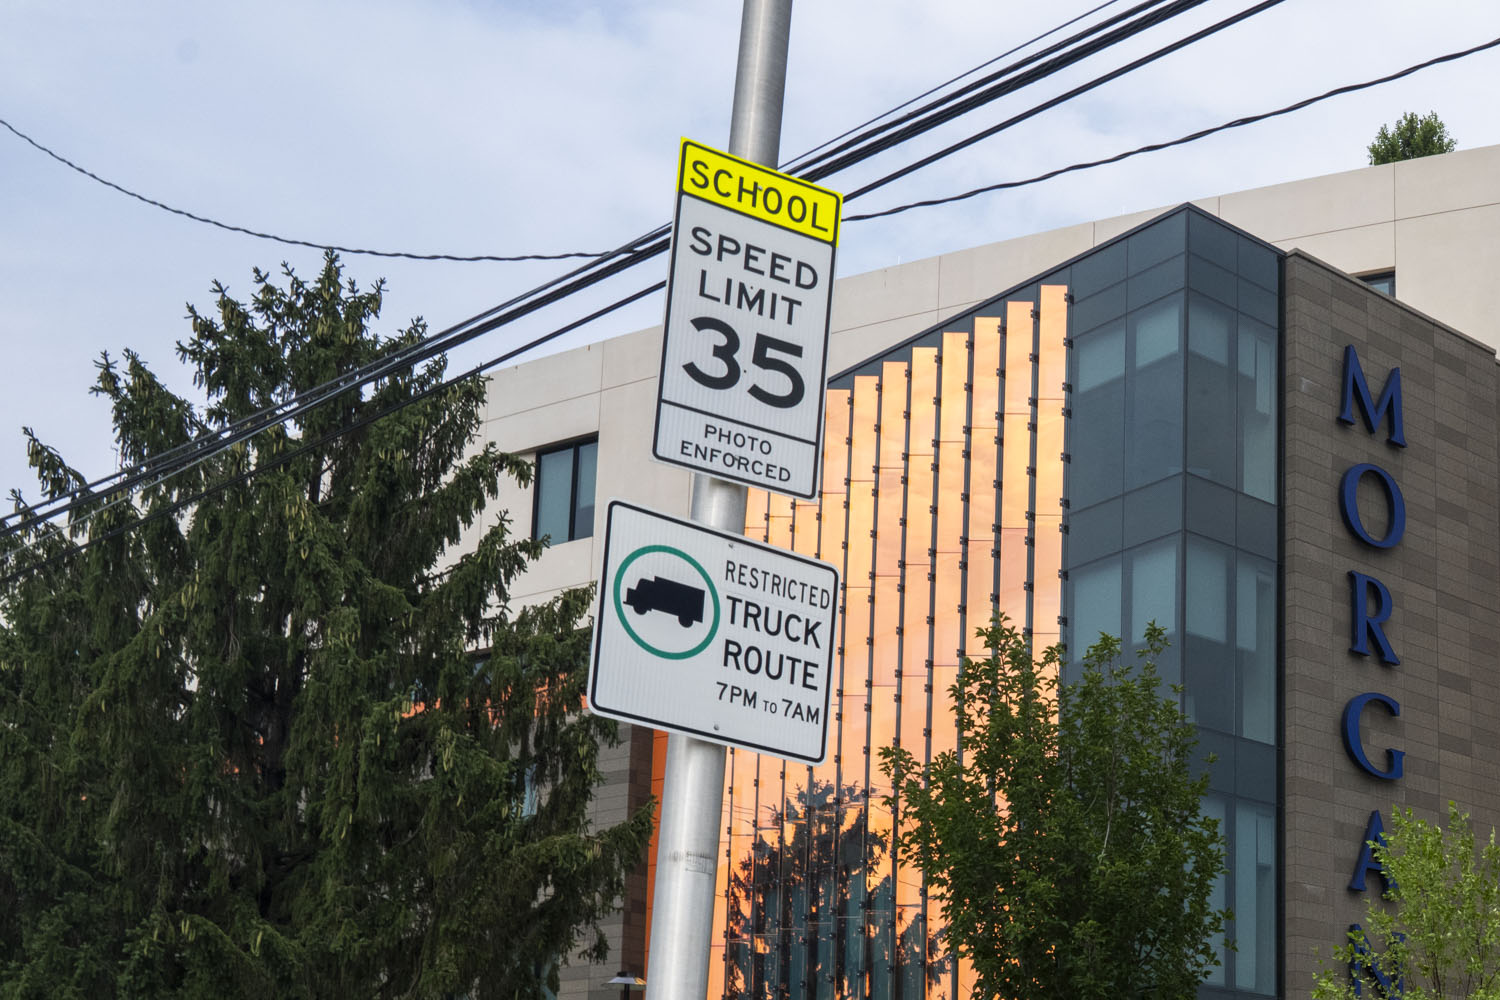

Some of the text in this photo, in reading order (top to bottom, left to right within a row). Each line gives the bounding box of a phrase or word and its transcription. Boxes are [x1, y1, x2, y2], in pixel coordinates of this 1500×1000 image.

[690, 160, 828, 232] SCHOOL
[689, 226, 818, 290] SPEED
[698, 269, 802, 325] LIMIT
[682, 316, 805, 409] 35
[680, 440, 791, 482] ENFORCED
[704, 424, 772, 455] PHOTO
[725, 560, 830, 610] RESTRICTED
[726, 595, 822, 649] TRUCK
[723, 639, 819, 691] ROUTE
[716, 681, 820, 725] 7PM TO 7AM
